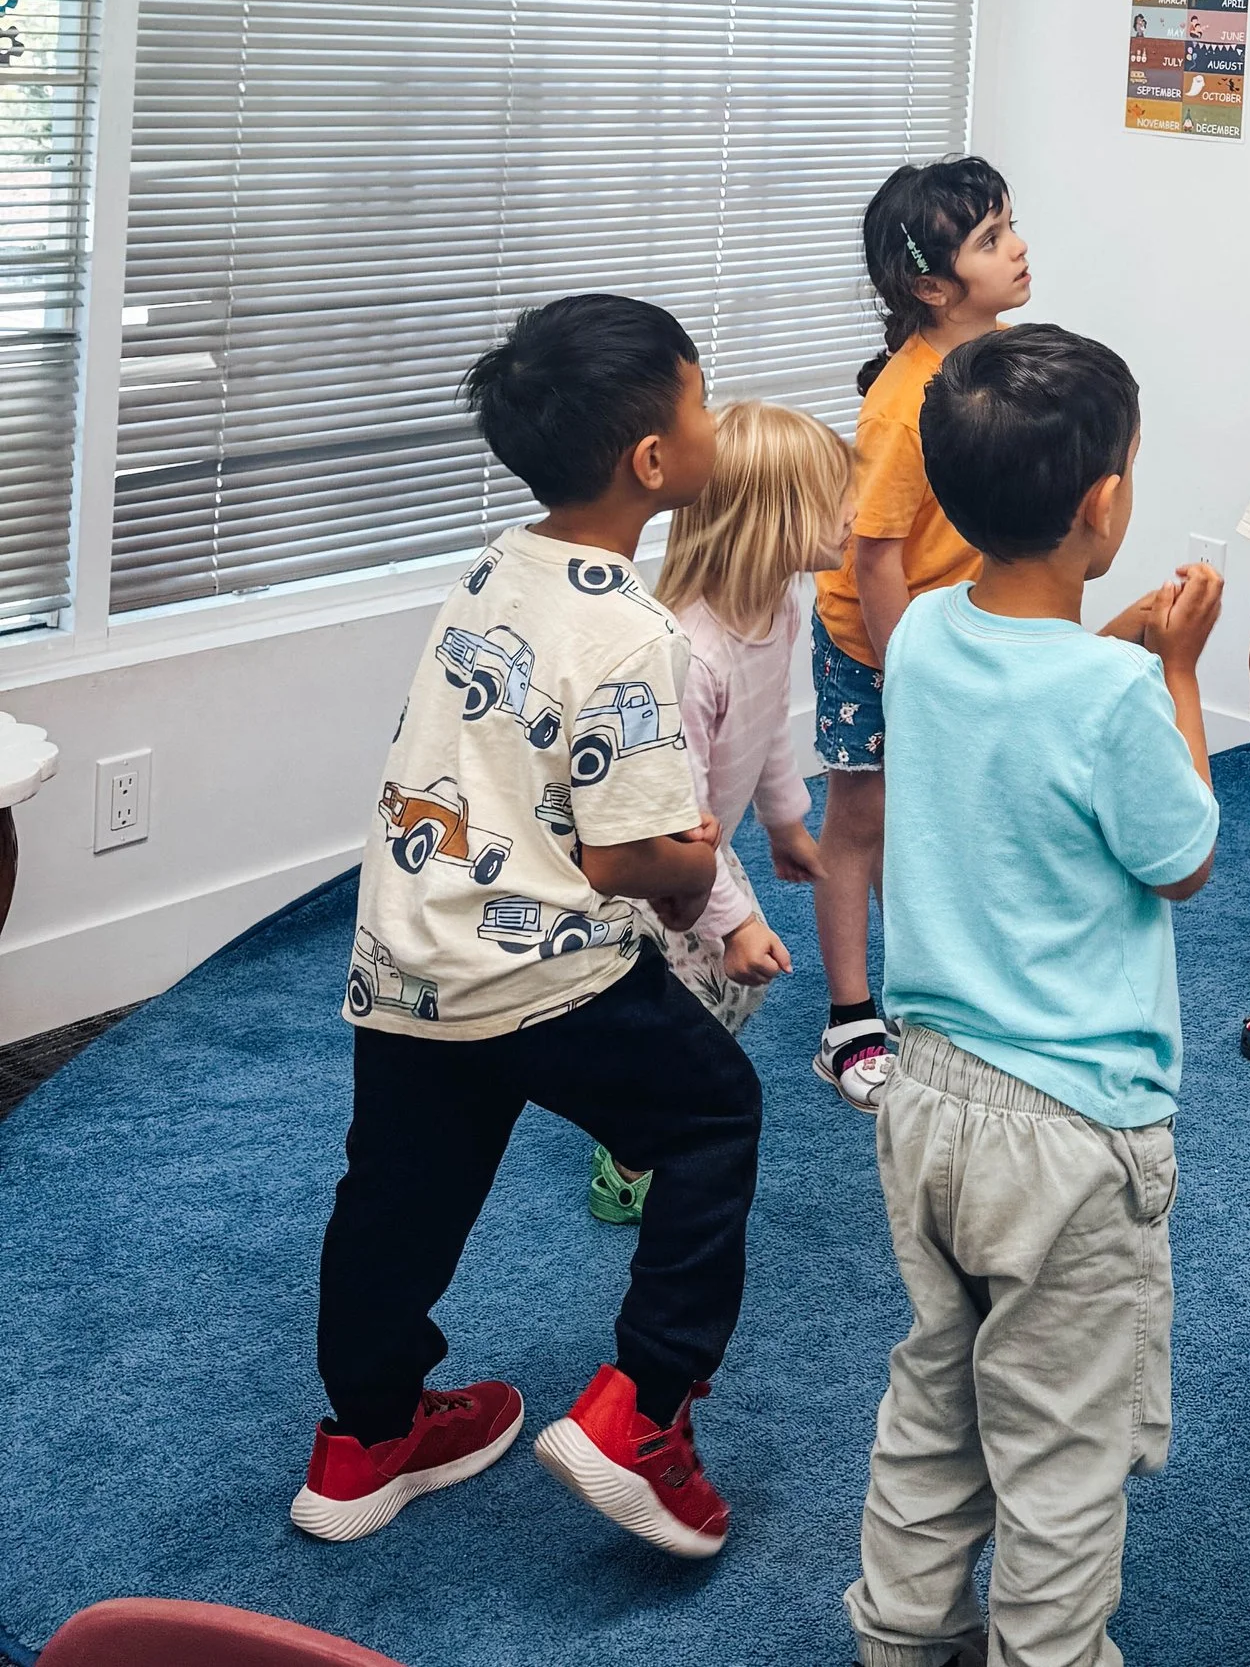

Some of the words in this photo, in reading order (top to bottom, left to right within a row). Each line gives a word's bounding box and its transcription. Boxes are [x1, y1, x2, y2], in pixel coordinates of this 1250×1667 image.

[1222, 0, 1246, 8] APRIL
[1167, 28, 1185, 37] MAY
[1220, 31, 1245, 41] JUNE
[1162, 57, 1183, 67] JULY
[1207, 61, 1243, 70] AUGUST
[1137, 86, 1181, 98] SEPTEMBER
[1202, 92, 1241, 103] OCTOBER
[1137, 118, 1180, 130] NOVEMBER
[1196, 124, 1239, 135] DECEMBER
